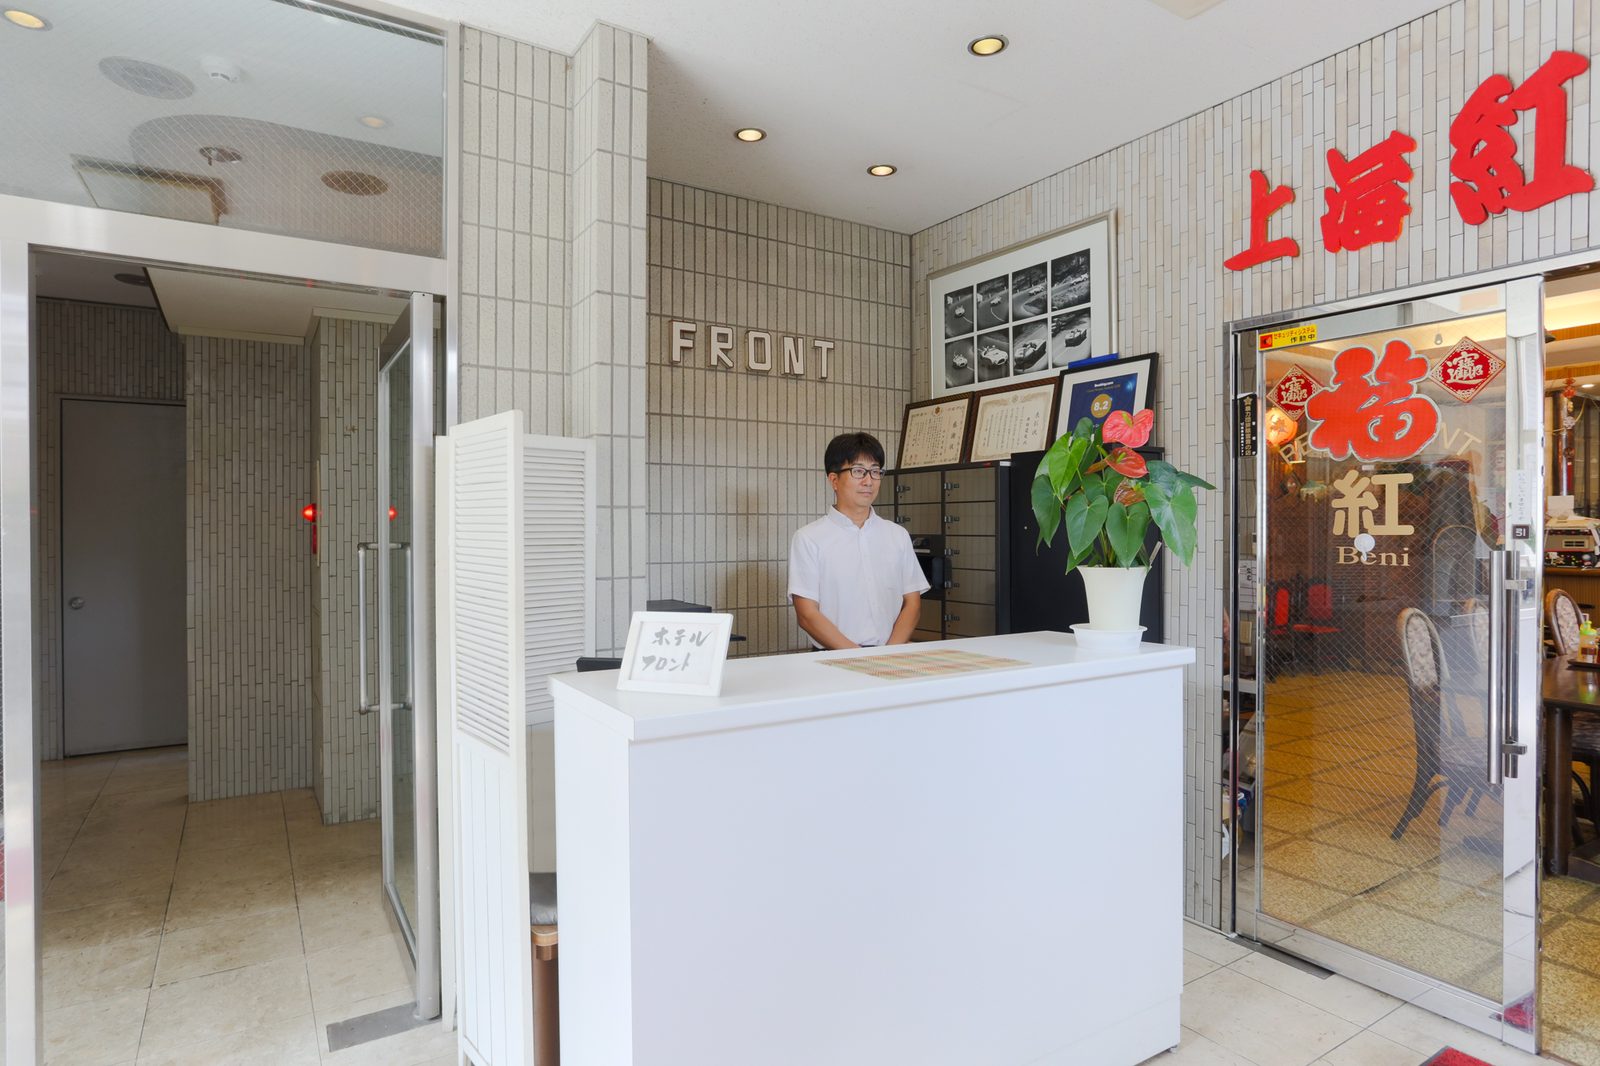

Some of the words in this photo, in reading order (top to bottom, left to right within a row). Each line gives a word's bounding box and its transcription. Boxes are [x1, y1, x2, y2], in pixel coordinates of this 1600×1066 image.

[1224, 50, 1593, 271] 上海紅
[669, 319, 835, 380] FRONT
[1094, 400, 1109, 412] 8.2
[1306, 338, 1441, 462] 福
[1331, 469, 1415, 538] 紅
[1336, 546, 1411, 566] Beni
[651, 626, 713, 647] ホテル
[642, 652, 691, 672] フロント
